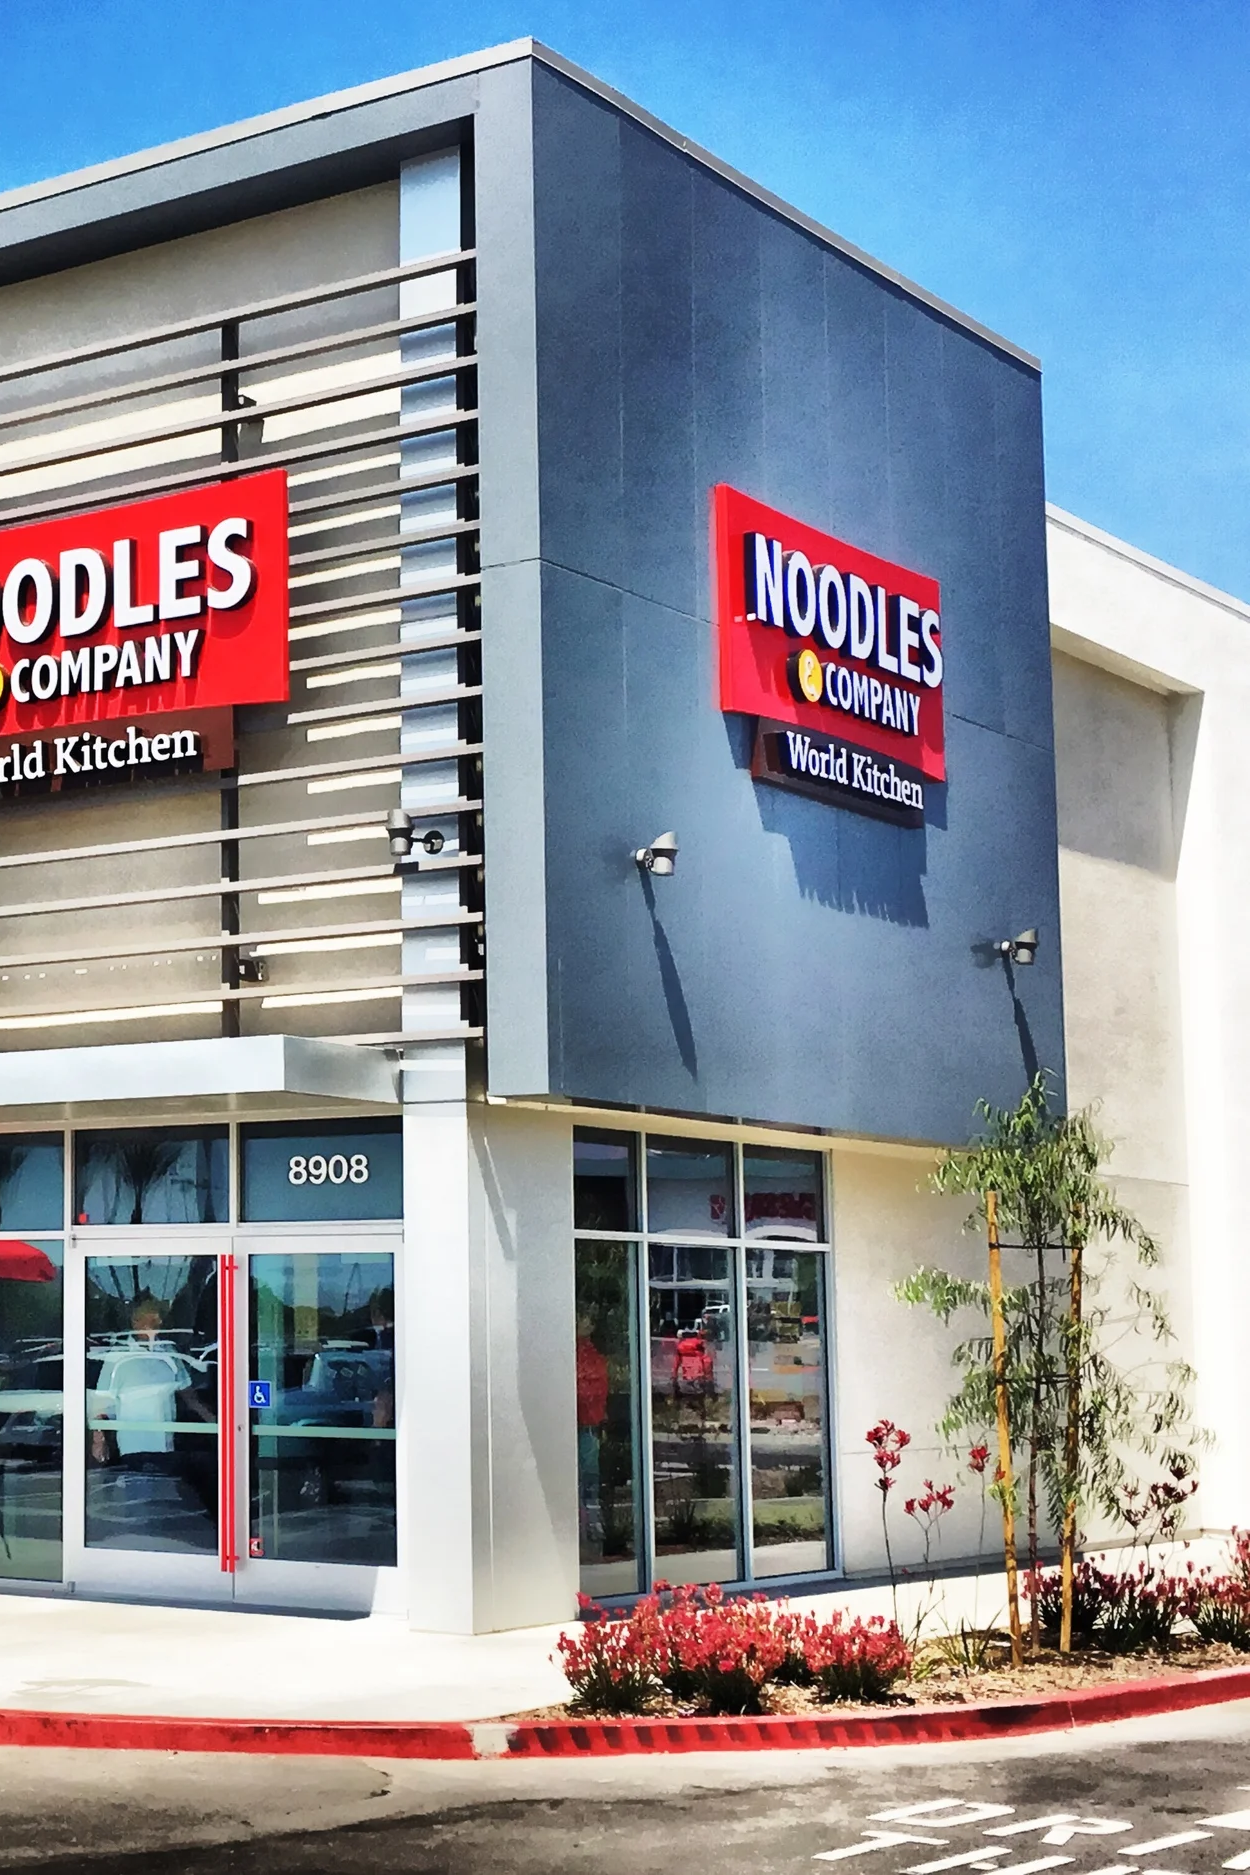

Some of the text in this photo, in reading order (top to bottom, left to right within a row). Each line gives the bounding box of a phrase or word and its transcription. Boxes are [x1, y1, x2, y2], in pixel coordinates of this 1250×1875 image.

[755, 532, 944, 689] NOODLES
[10, 628, 200, 703] COMPANY
[825, 662, 921, 736] COMPANY
[53, 726, 200, 775] Kitchen
[786, 730, 924, 810] World Kitchen
[287, 1153, 370, 1186] 8908
[866, 1797, 1250, 1871] DRI
